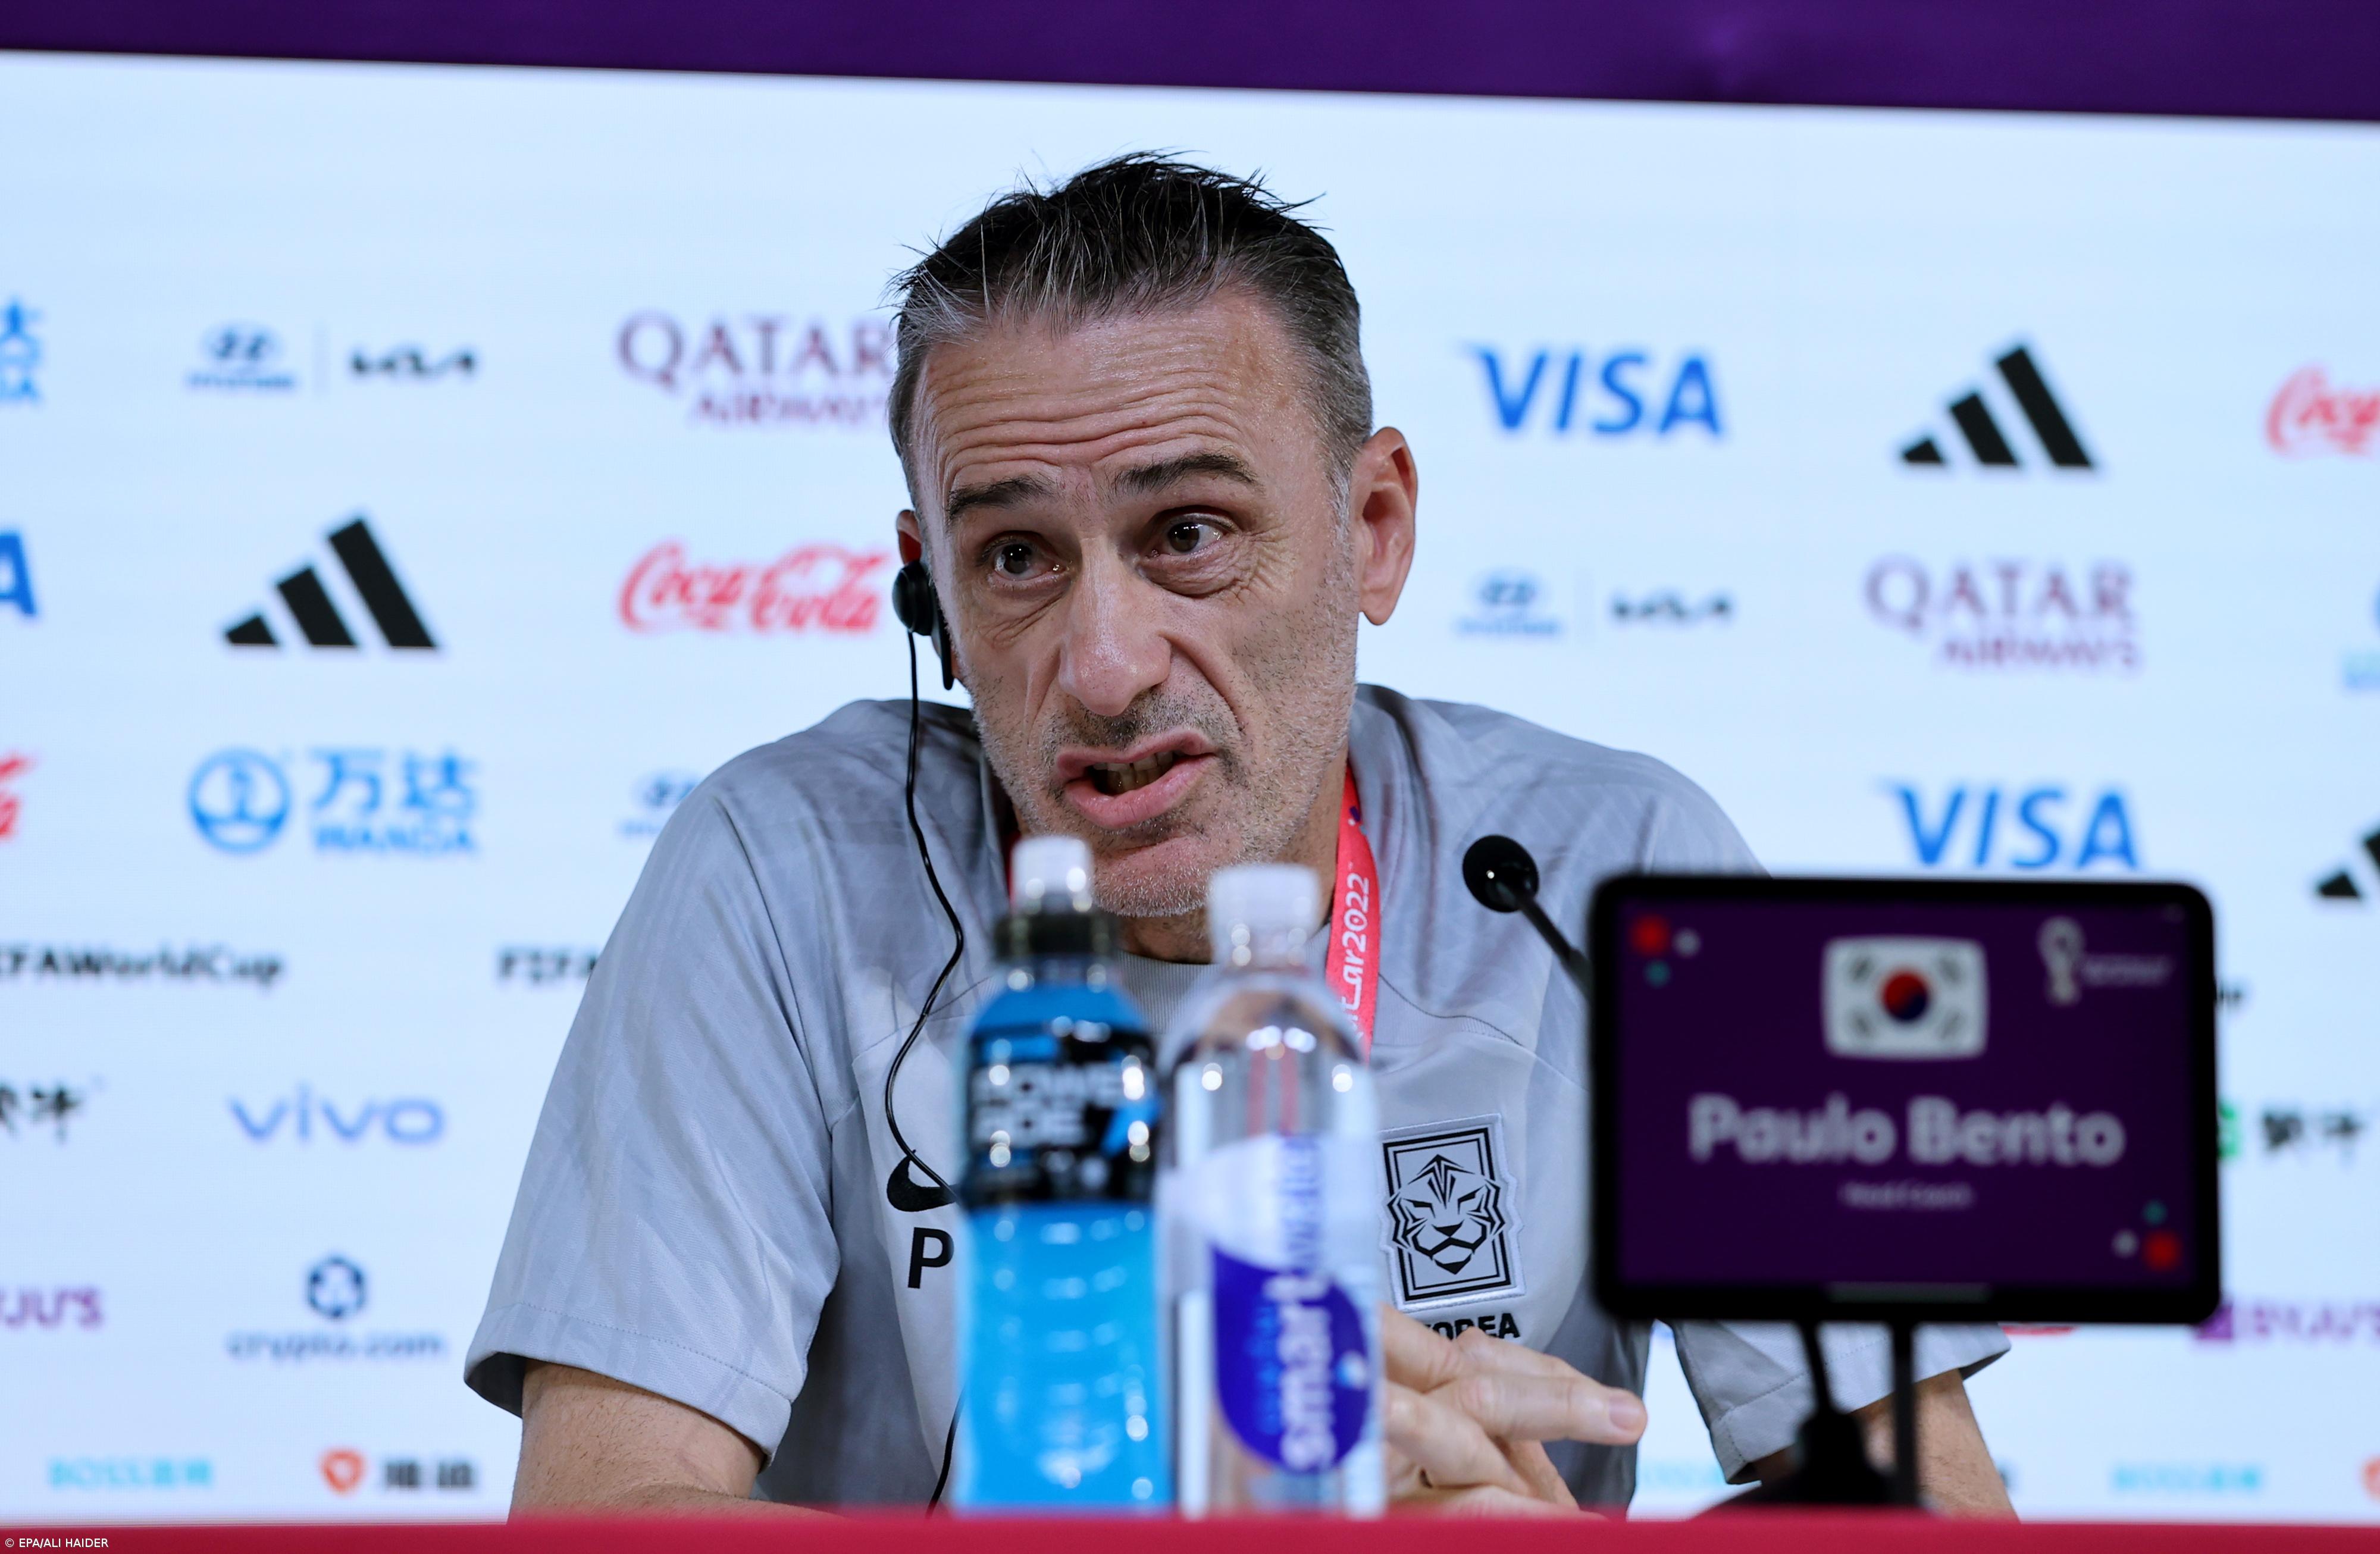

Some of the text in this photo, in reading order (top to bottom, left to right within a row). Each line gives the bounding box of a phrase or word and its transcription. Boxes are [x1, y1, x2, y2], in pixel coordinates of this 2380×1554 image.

[617, 311, 891, 393] QATAR
[1461, 346, 1726, 438] VISA
[1864, 553, 2134, 635] QATAR
[1879, 781, 2140, 869] VISA
[228, 1082, 445, 1145] vivo
[1689, 1092, 2124, 1166] Paulo Bento
[908, 1227, 954, 1289] P
